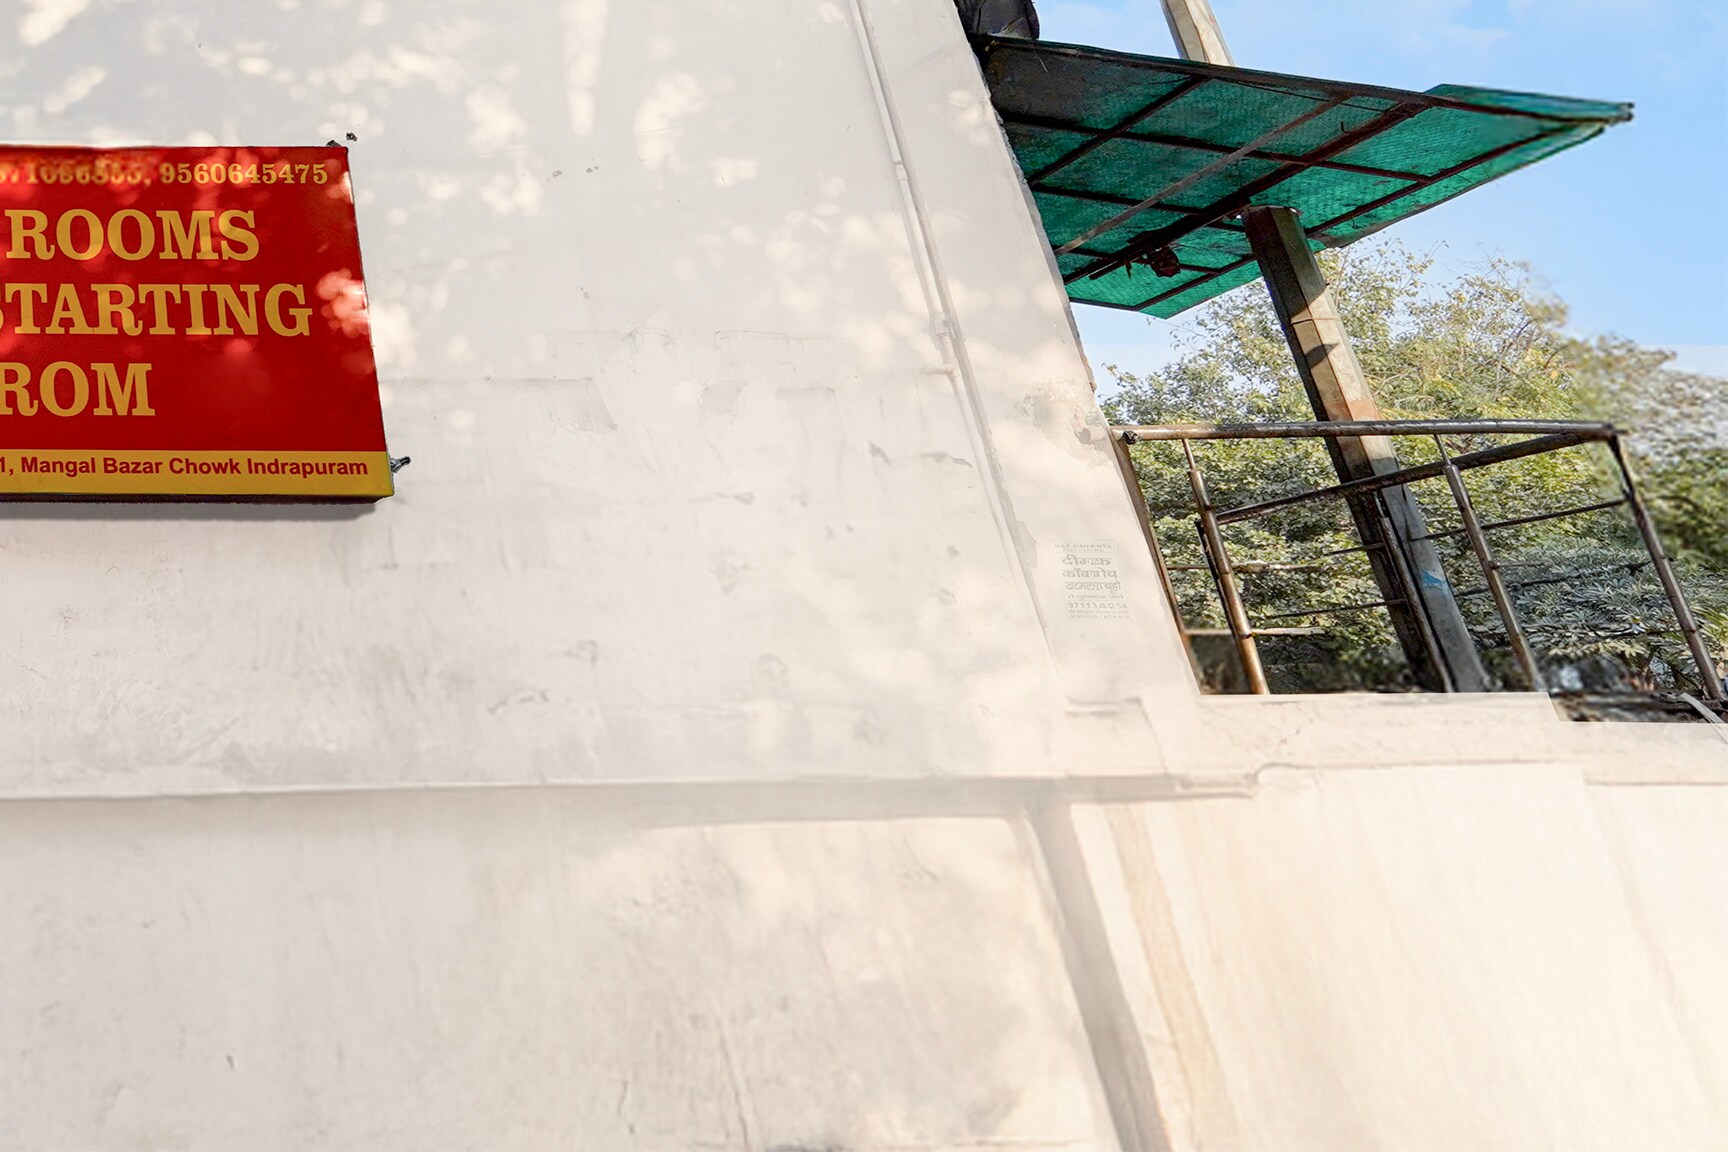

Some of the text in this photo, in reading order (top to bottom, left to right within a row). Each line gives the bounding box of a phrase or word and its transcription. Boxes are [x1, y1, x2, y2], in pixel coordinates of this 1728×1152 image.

[161, 163, 328, 185] 9560645475
[5, 209, 258, 260] ROOMS
[21, 457, 96, 478] Mangal
[103, 457, 163, 474] Bazar
[169, 458, 241, 474] Chowk
[247, 458, 368, 479] Indrapuram
